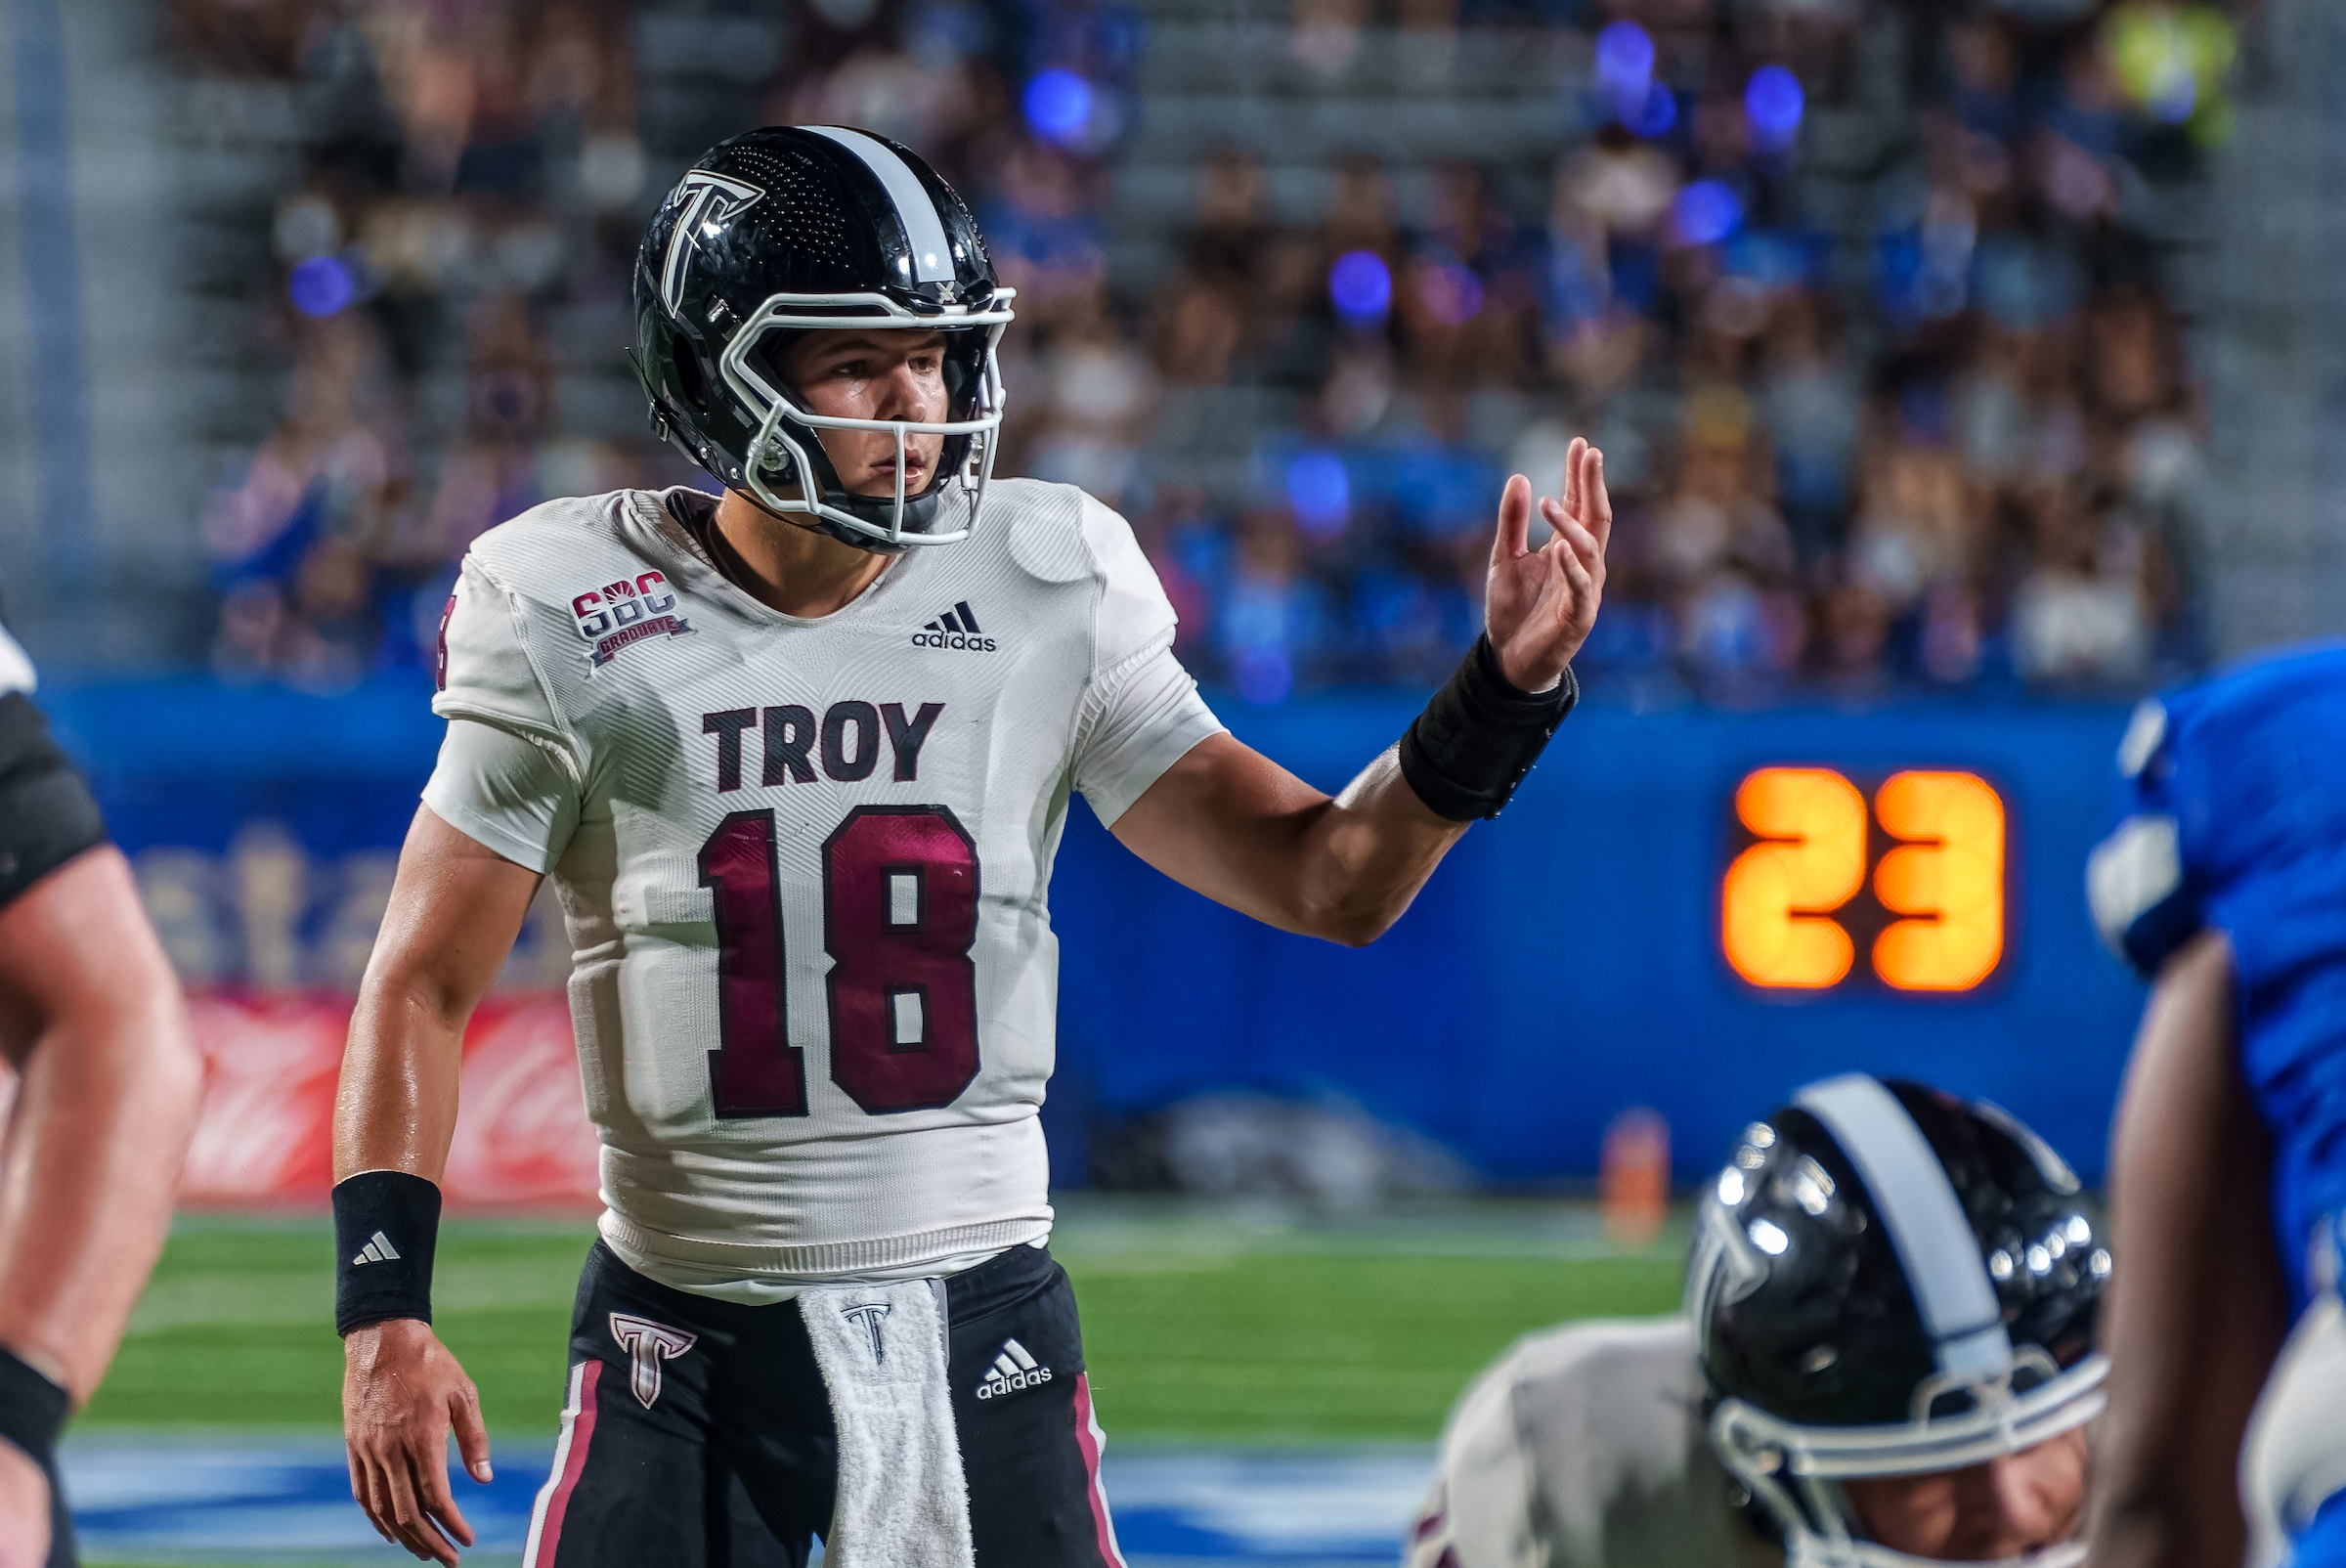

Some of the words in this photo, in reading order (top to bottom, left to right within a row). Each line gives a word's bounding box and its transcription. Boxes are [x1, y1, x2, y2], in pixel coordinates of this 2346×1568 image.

[572, 571, 676, 637] SBC
[600, 616, 678, 655] GRADUATE
[912, 629, 996, 652] adidas
[702, 700, 946, 794] TROY
[1721, 766, 2005, 991] 23
[697, 805, 981, 1118] 18
[976, 1365, 1053, 1401] adidas
